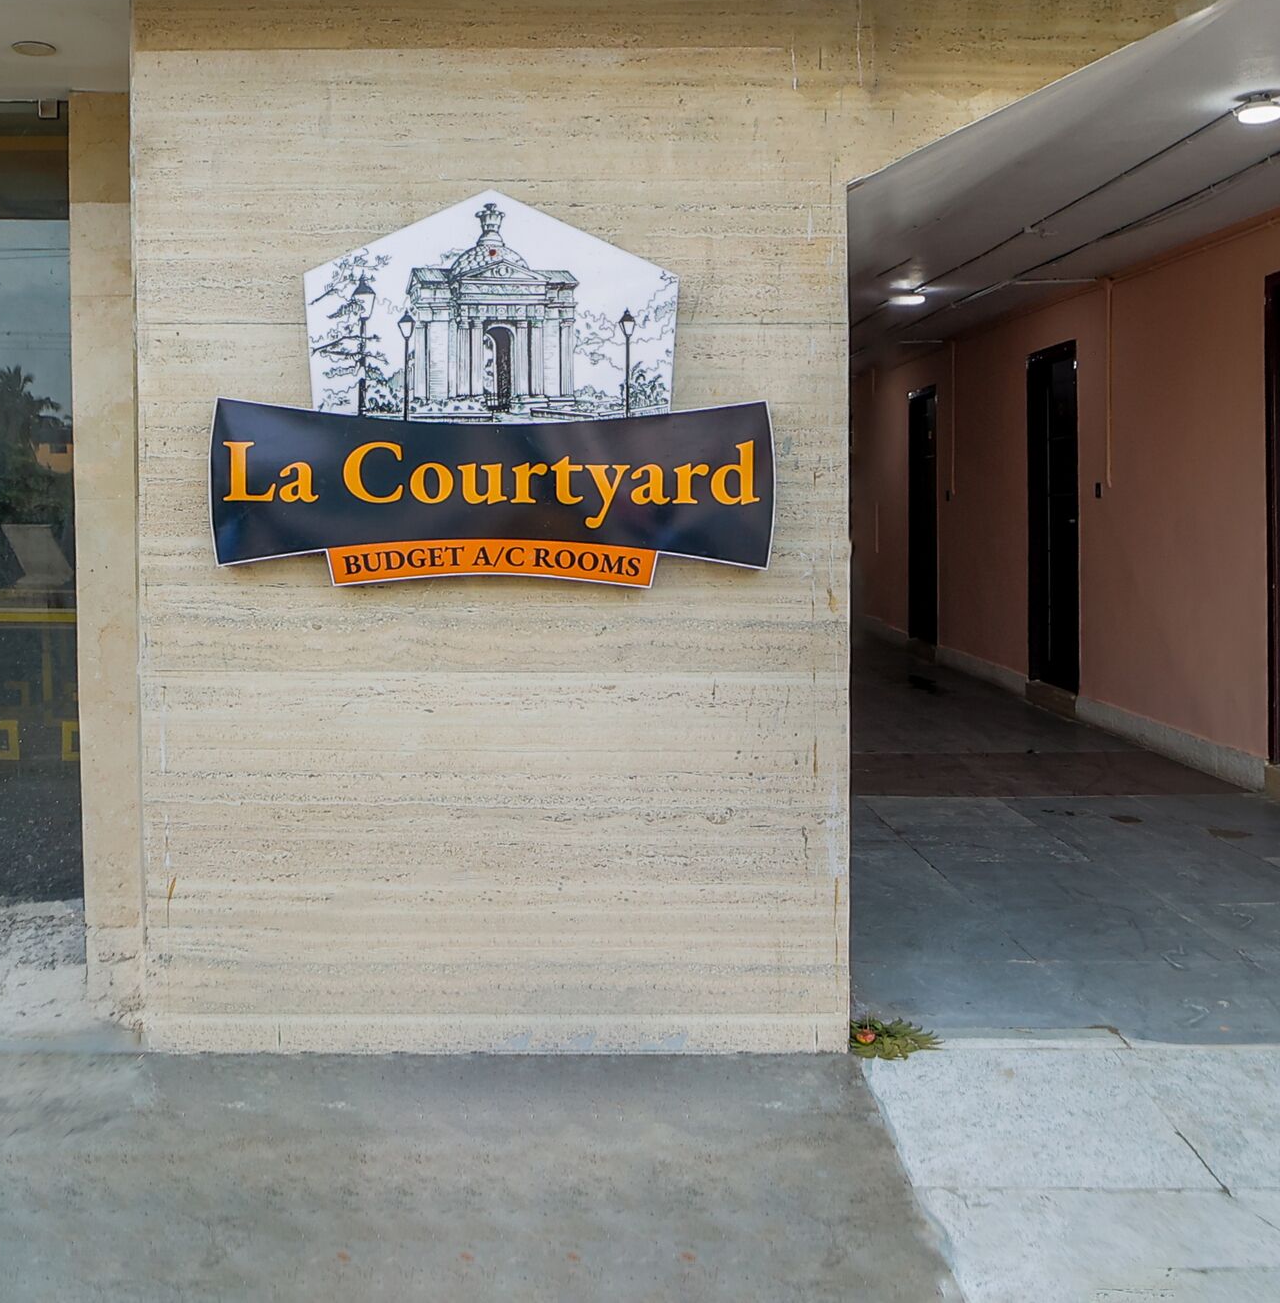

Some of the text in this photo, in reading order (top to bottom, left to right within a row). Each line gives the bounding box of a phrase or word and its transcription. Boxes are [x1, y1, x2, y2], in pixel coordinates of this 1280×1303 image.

[222, 440, 761, 529] La Courtyard
[343, 546, 641, 577] BUDGET A/C ROOMS
